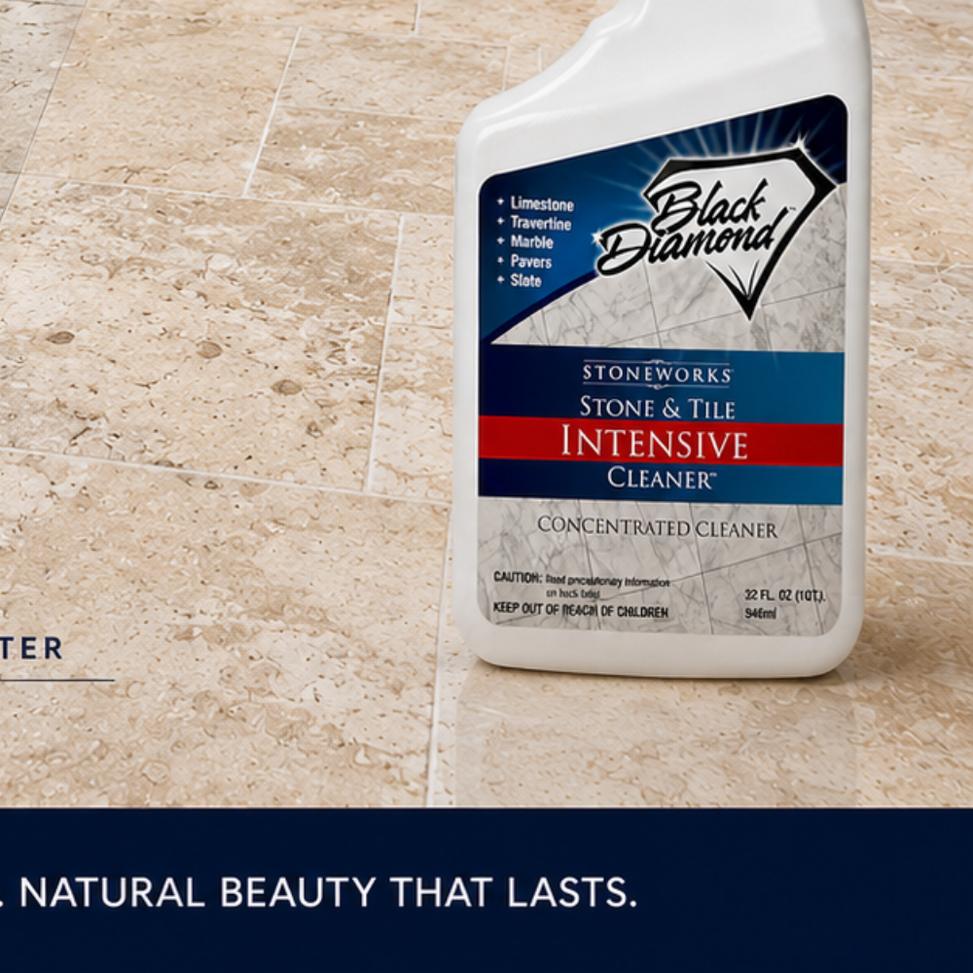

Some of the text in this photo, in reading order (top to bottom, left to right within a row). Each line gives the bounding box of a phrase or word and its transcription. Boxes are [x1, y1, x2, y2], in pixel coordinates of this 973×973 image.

[510, 196, 574, 212] Limestone
[646, 178, 769, 232] Black
[510, 215, 572, 231] Travertine
[511, 235, 554, 249] Marble
[596, 206, 790, 276] Diamond
[511, 254, 552, 269] Pavers
[510, 273, 542, 288] Slate
[580, 395, 736, 420] STONE & TILE
[561, 424, 748, 459] INTENSIVE
[537, 515, 778, 539] CONCENTRATED CLEANER
[493, 570, 543, 584] CAUTION:
[493, 601, 519, 613] KEEP
[522, 602, 544, 615] OUT
[545, 603, 560, 615] OF
[601, 605, 614, 617] OF
